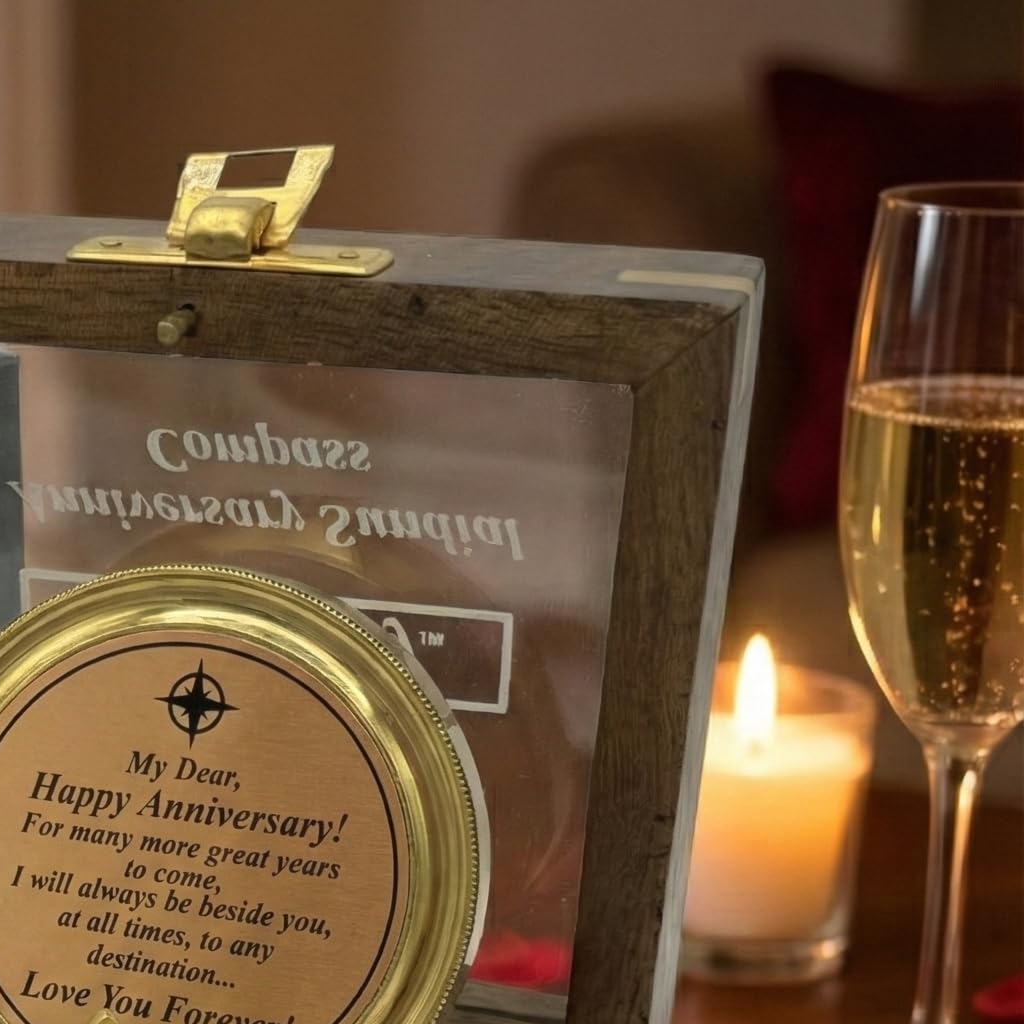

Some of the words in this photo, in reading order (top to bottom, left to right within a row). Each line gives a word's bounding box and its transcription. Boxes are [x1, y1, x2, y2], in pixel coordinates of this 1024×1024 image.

[125, 750, 168, 783] My
[174, 756, 241, 793] Dear,
[29, 771, 132, 820] Happy
[135, 789, 349, 849] Anniversary!
[21, 811, 65, 838] For
[69, 825, 134, 854] many
[139, 835, 201, 859] more
[203, 845, 271, 871] great
[272, 855, 341, 880] years
[11, 865, 25, 887] I
[31, 870, 74, 895] will
[77, 877, 158, 912] always
[163, 889, 193, 914] be
[198, 894, 275, 927] beside
[276, 913, 331, 941] you,
[124, 859, 147, 880] to
[153, 867, 221, 896] come,
[57, 910, 82, 929] at
[86, 911, 120, 935] all
[123, 916, 191, 952] times,
[199, 931, 223, 952] to
[229, 939, 275, 966] any
[86, 943, 236, 989] destination...
[20, 970, 91, 1007] Love
[102, 983, 151, 1019] You
